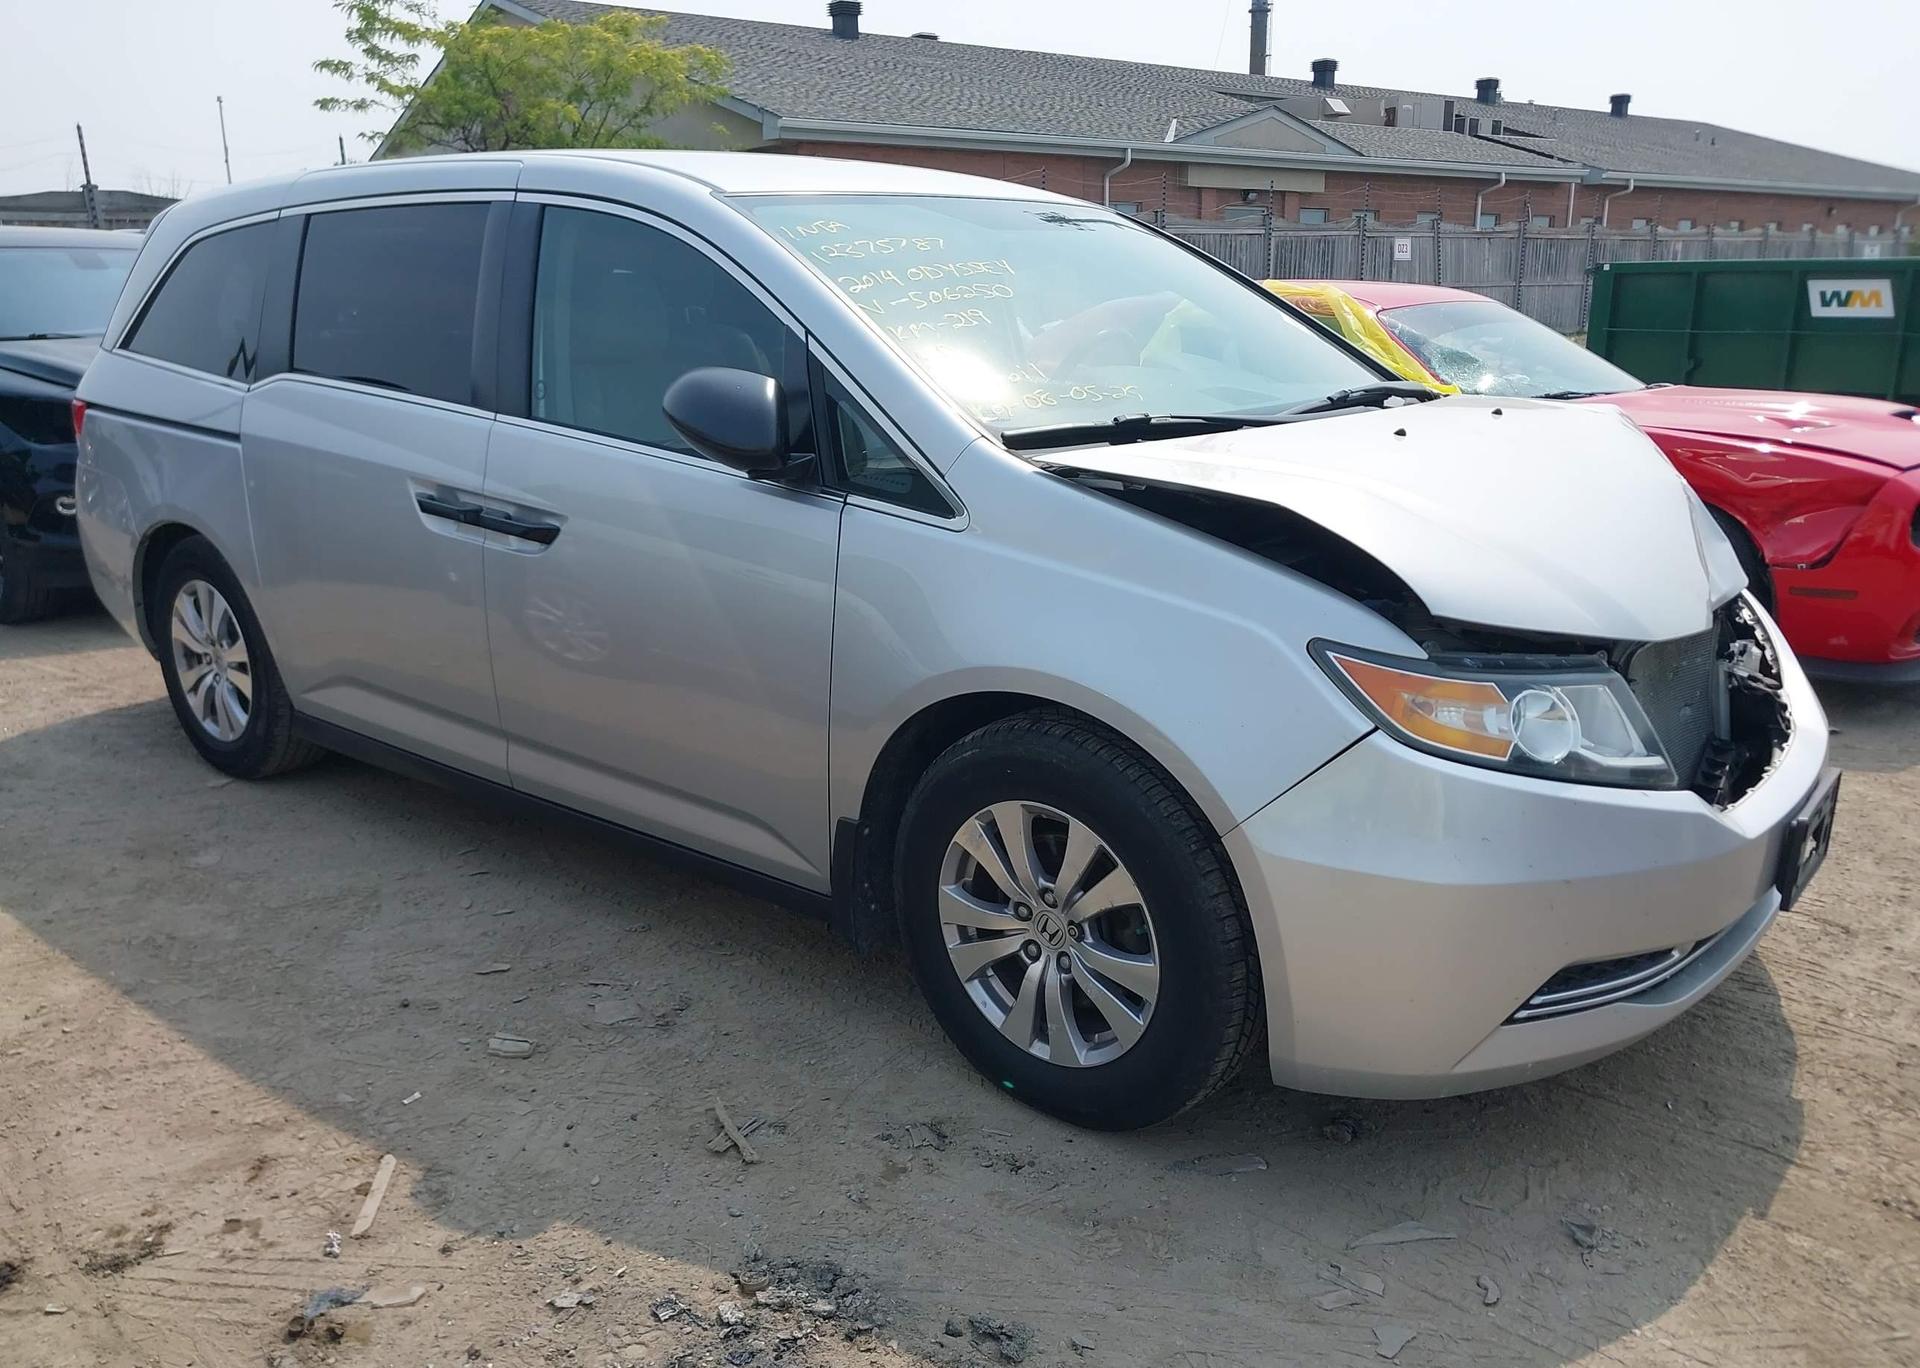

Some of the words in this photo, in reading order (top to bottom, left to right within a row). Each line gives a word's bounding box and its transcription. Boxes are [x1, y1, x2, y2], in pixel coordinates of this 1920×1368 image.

[838, 269, 904, 293] 2014
[907, 260, 1015, 281] ODYSSEY
[1819, 290, 1884, 308] WM
